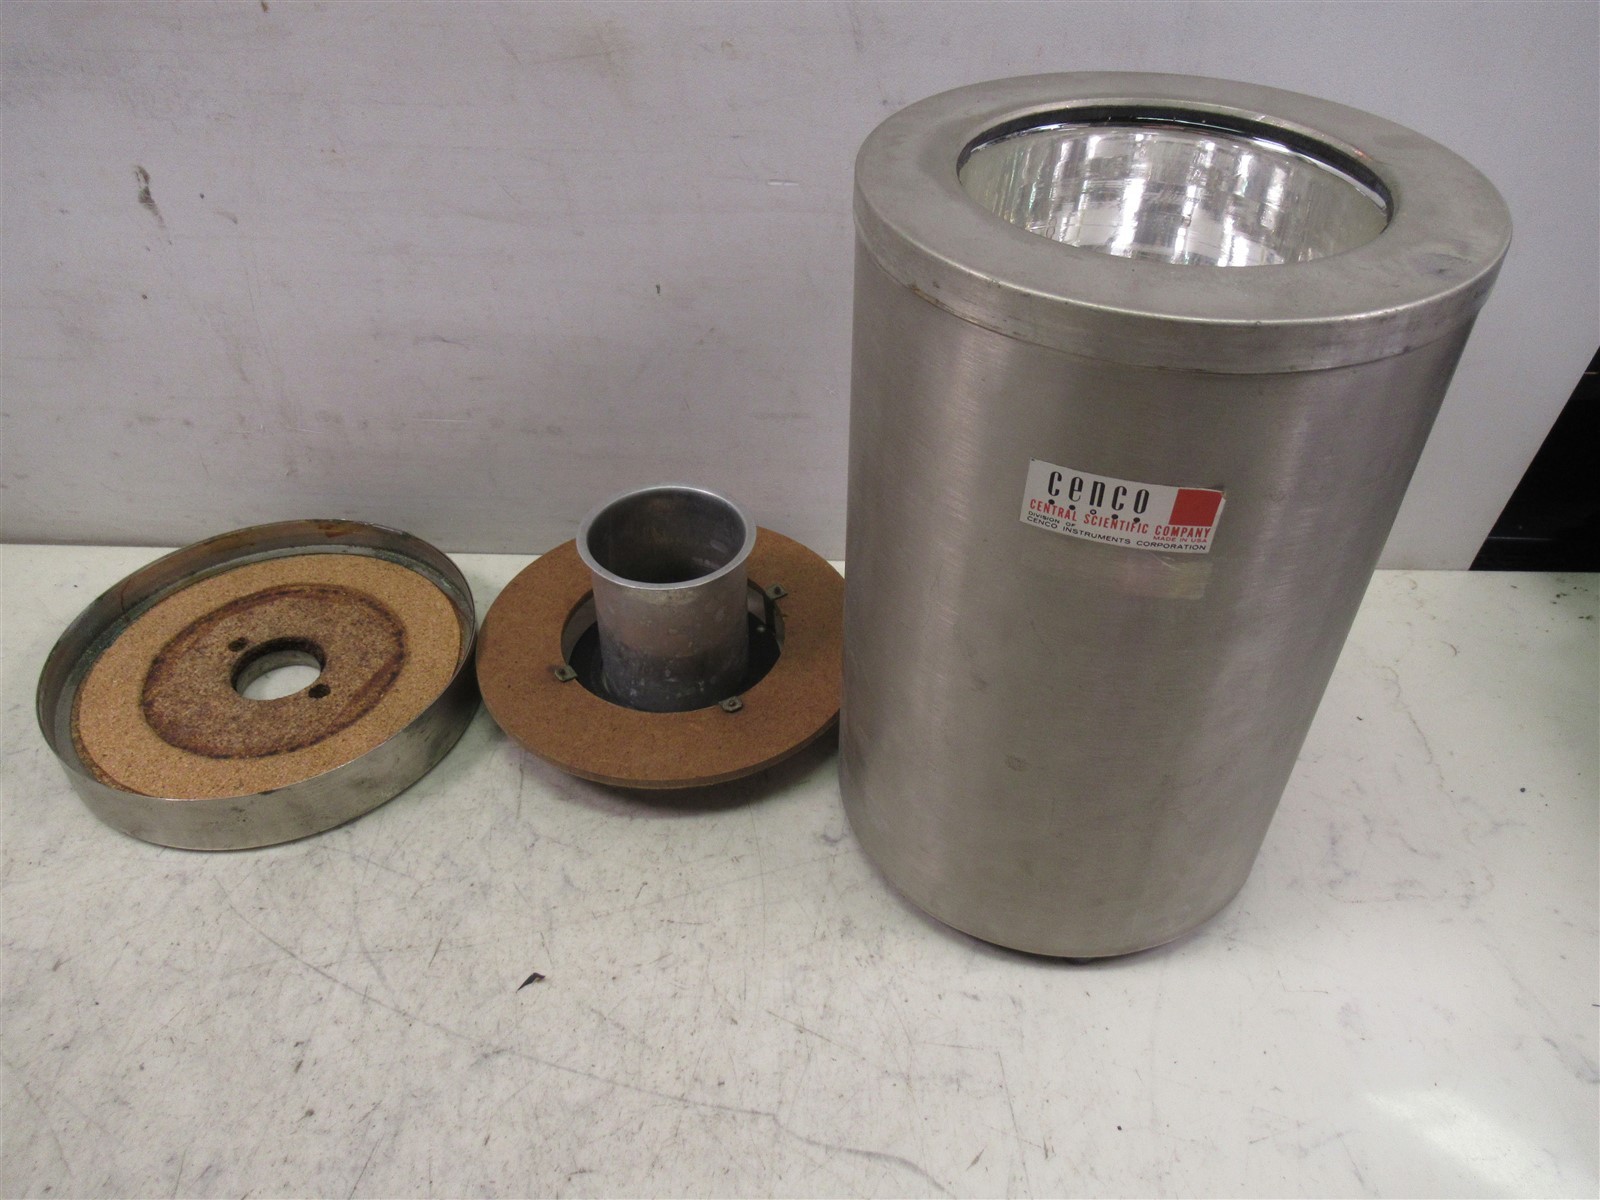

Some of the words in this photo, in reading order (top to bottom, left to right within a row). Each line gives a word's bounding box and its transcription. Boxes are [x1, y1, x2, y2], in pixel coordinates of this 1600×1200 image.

[1026, 516, 1058, 529] CENCO
[1062, 526, 1131, 545] INSTRUMENTS
[1136, 540, 1206, 550] CORPORATION
[1028, 511, 1060, 524] DIVISION
[1029, 499, 1077, 521] CENTRAL
[1083, 514, 1149, 534] SCIENTIFIC
[1154, 525, 1211, 538] COMPANY
